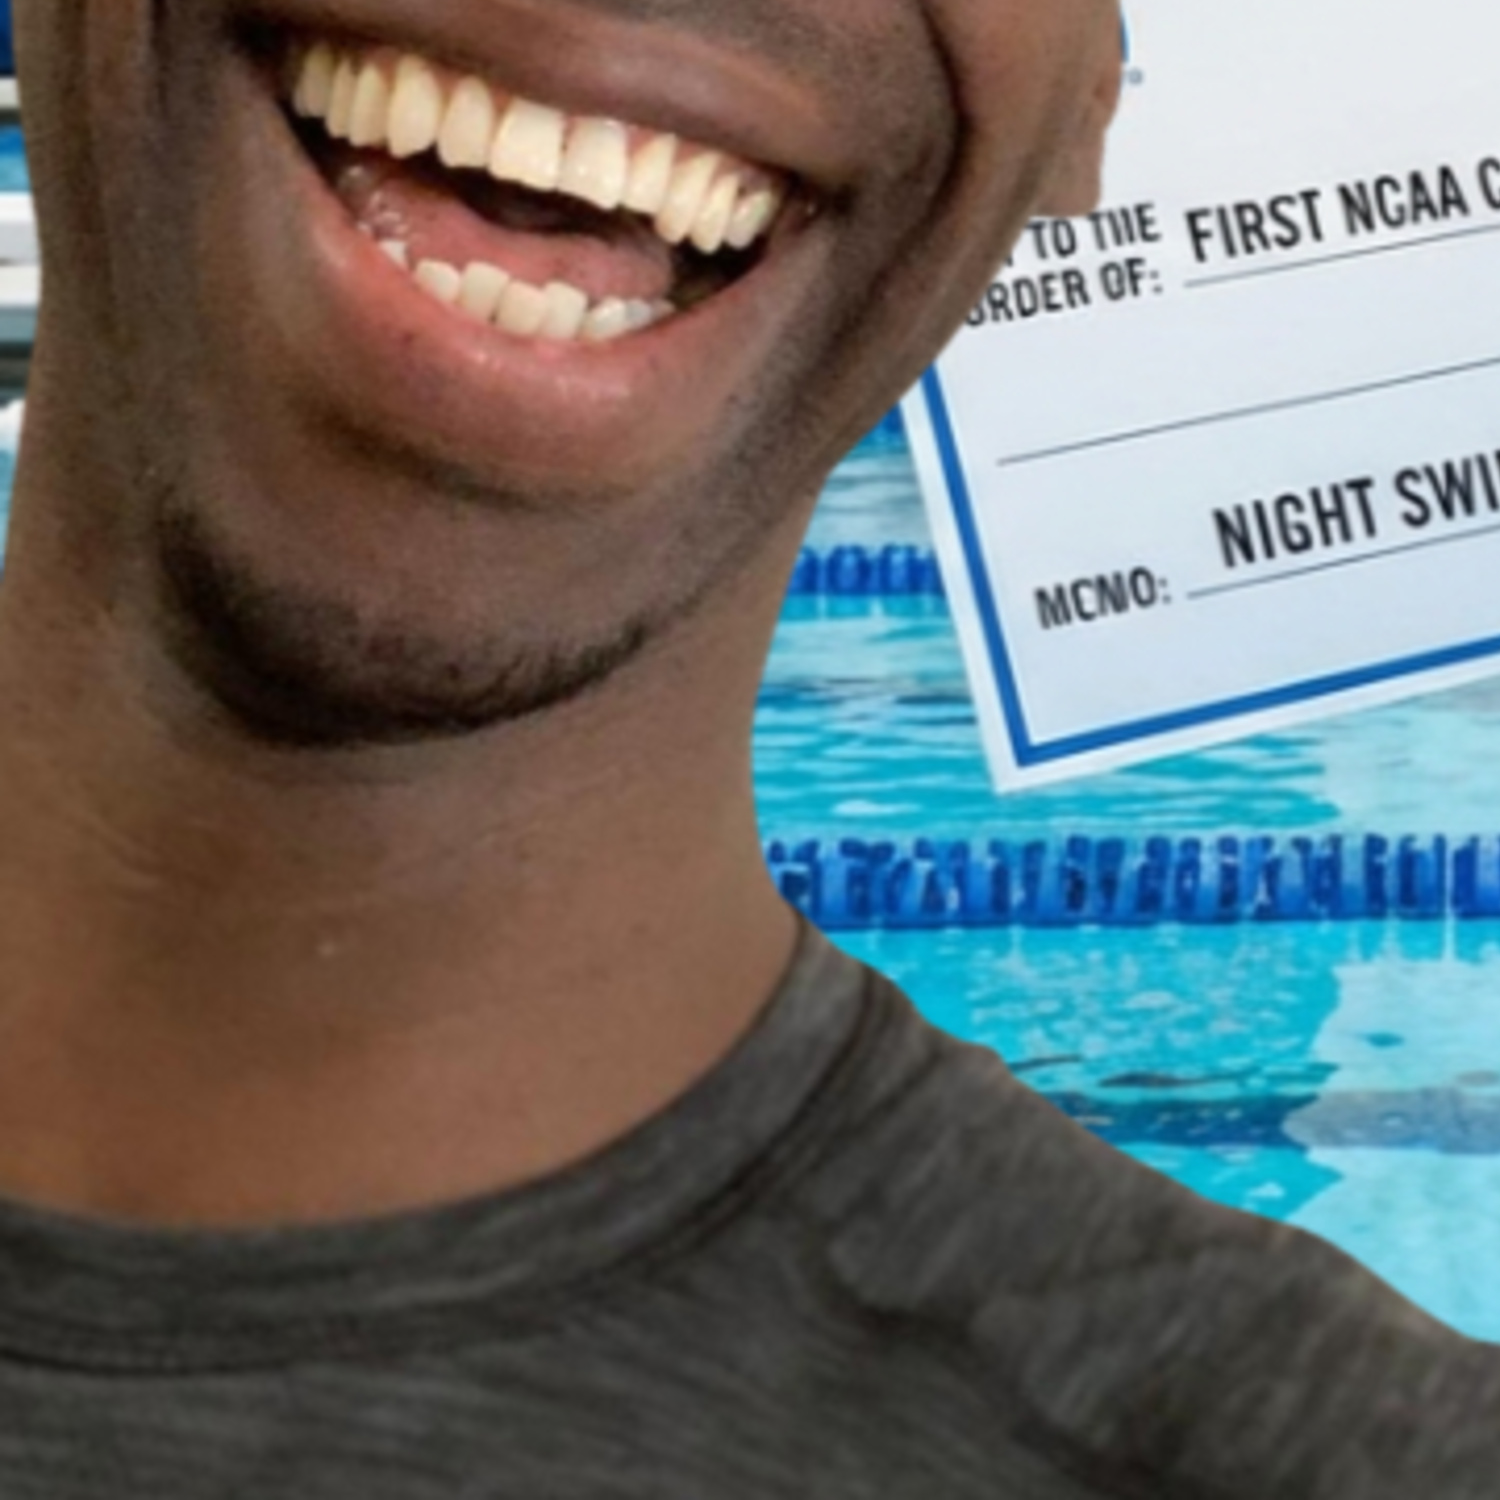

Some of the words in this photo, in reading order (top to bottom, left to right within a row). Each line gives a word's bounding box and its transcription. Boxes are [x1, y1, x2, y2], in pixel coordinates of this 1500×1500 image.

[1027, 218, 1077, 259] TO
[1184, 190, 1326, 263] FIRST
[1337, 165, 1470, 235] NCAA
[1100, 257, 1163, 301] OF:
[1213, 478, 1379, 569] NIGHT
